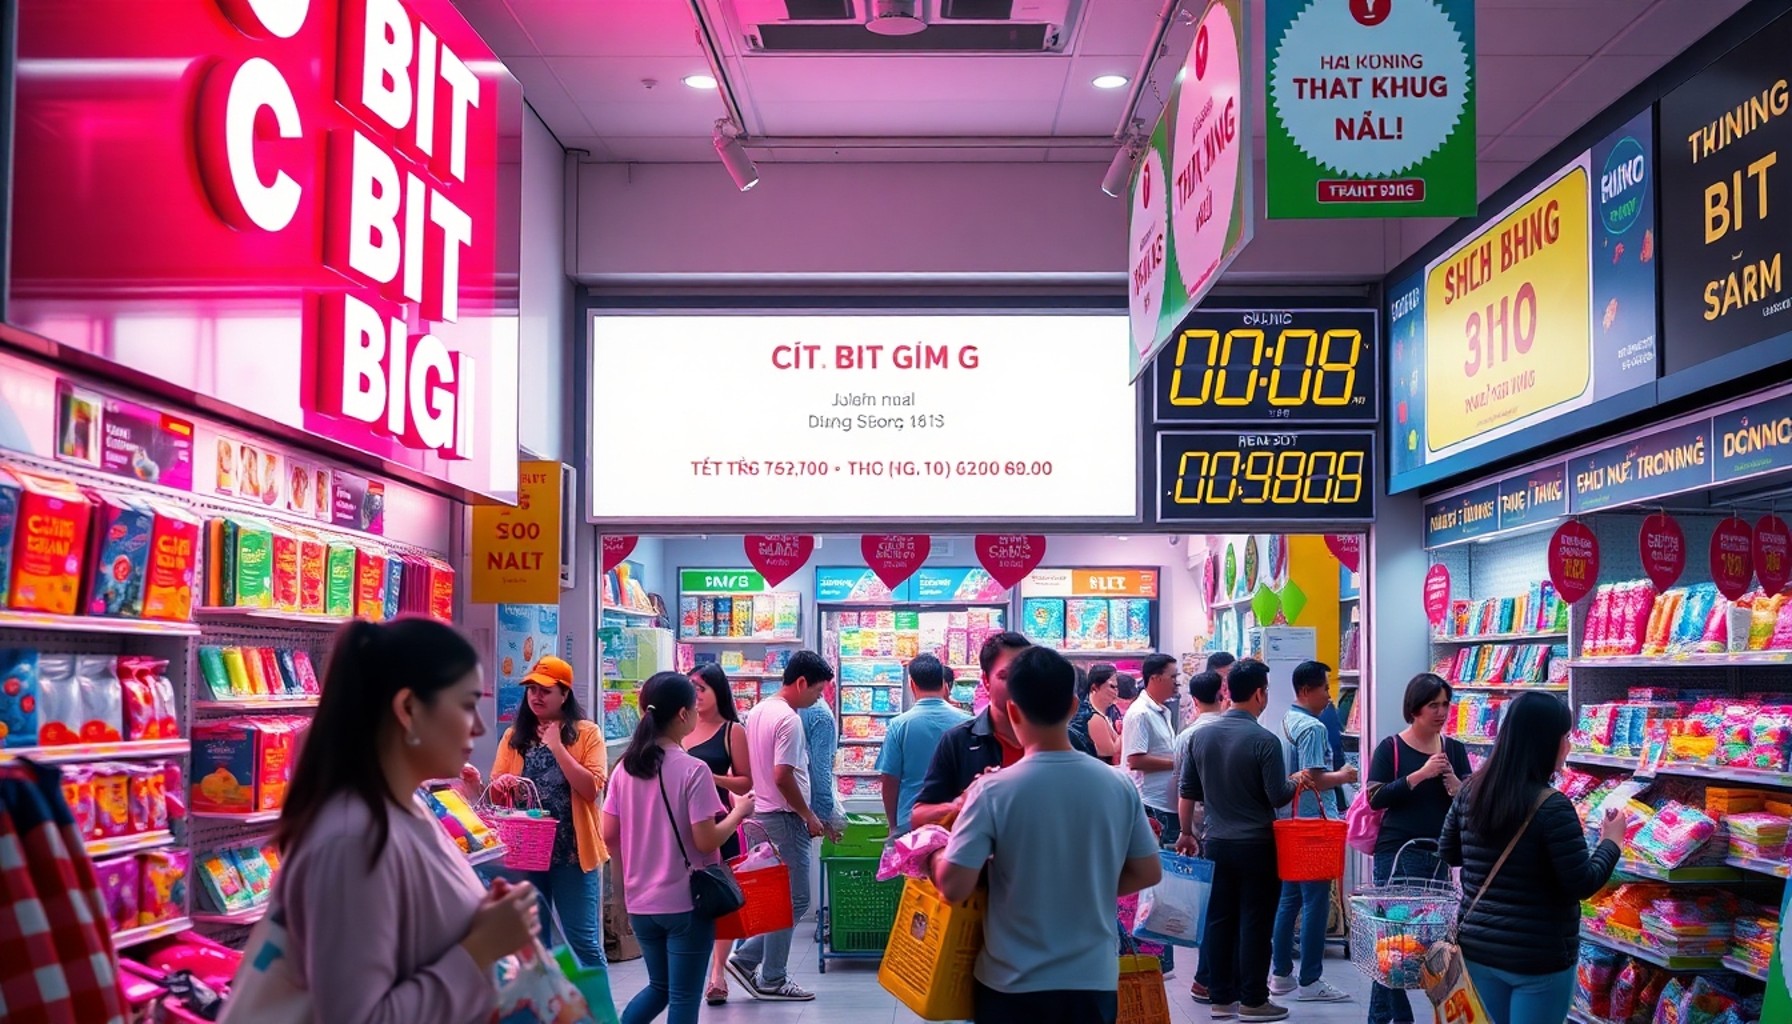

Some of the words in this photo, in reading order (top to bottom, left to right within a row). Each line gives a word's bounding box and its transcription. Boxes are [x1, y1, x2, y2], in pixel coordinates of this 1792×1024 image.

[362, 0, 480, 183] BIT
[1293, 77, 1362, 100] THAT
[1372, 75, 1448, 98] KHUG
[226, 57, 303, 232] C
[348, 129, 472, 324] BIT
[1704, 151, 1777, 245] BIT
[836, 345, 883, 369] BIT
[958, 345, 979, 369] G
[1169, 329, 1362, 406] 00:08
